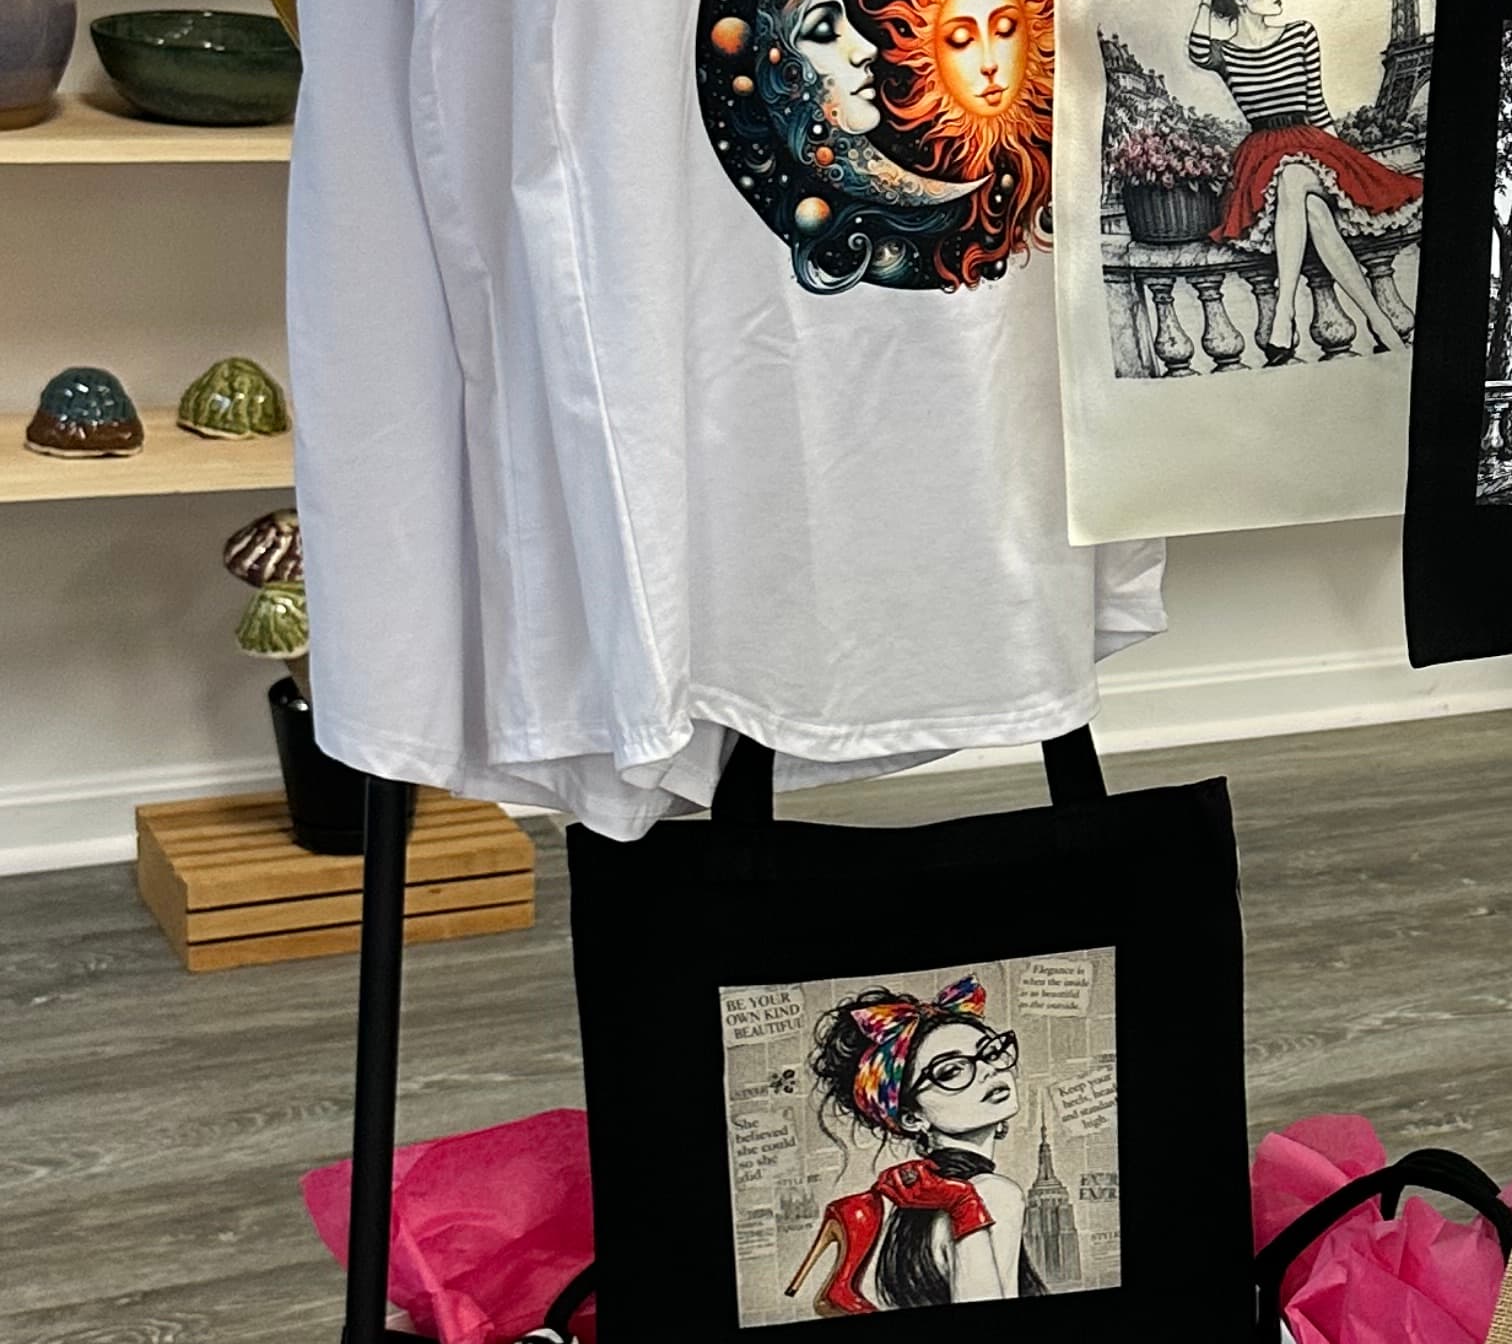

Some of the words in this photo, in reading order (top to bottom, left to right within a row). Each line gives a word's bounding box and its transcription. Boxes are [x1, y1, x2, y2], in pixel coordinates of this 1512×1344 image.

[726, 998, 746, 1012] BE
[748, 991, 791, 1008] YOUR
[726, 1011, 761, 1026] OWN
[764, 1003, 800, 1020] KIND
[732, 1118, 759, 1130] She
[736, 1125, 789, 1144] believed
[737, 1146, 759, 1156] she
[761, 1136, 796, 1152] could
